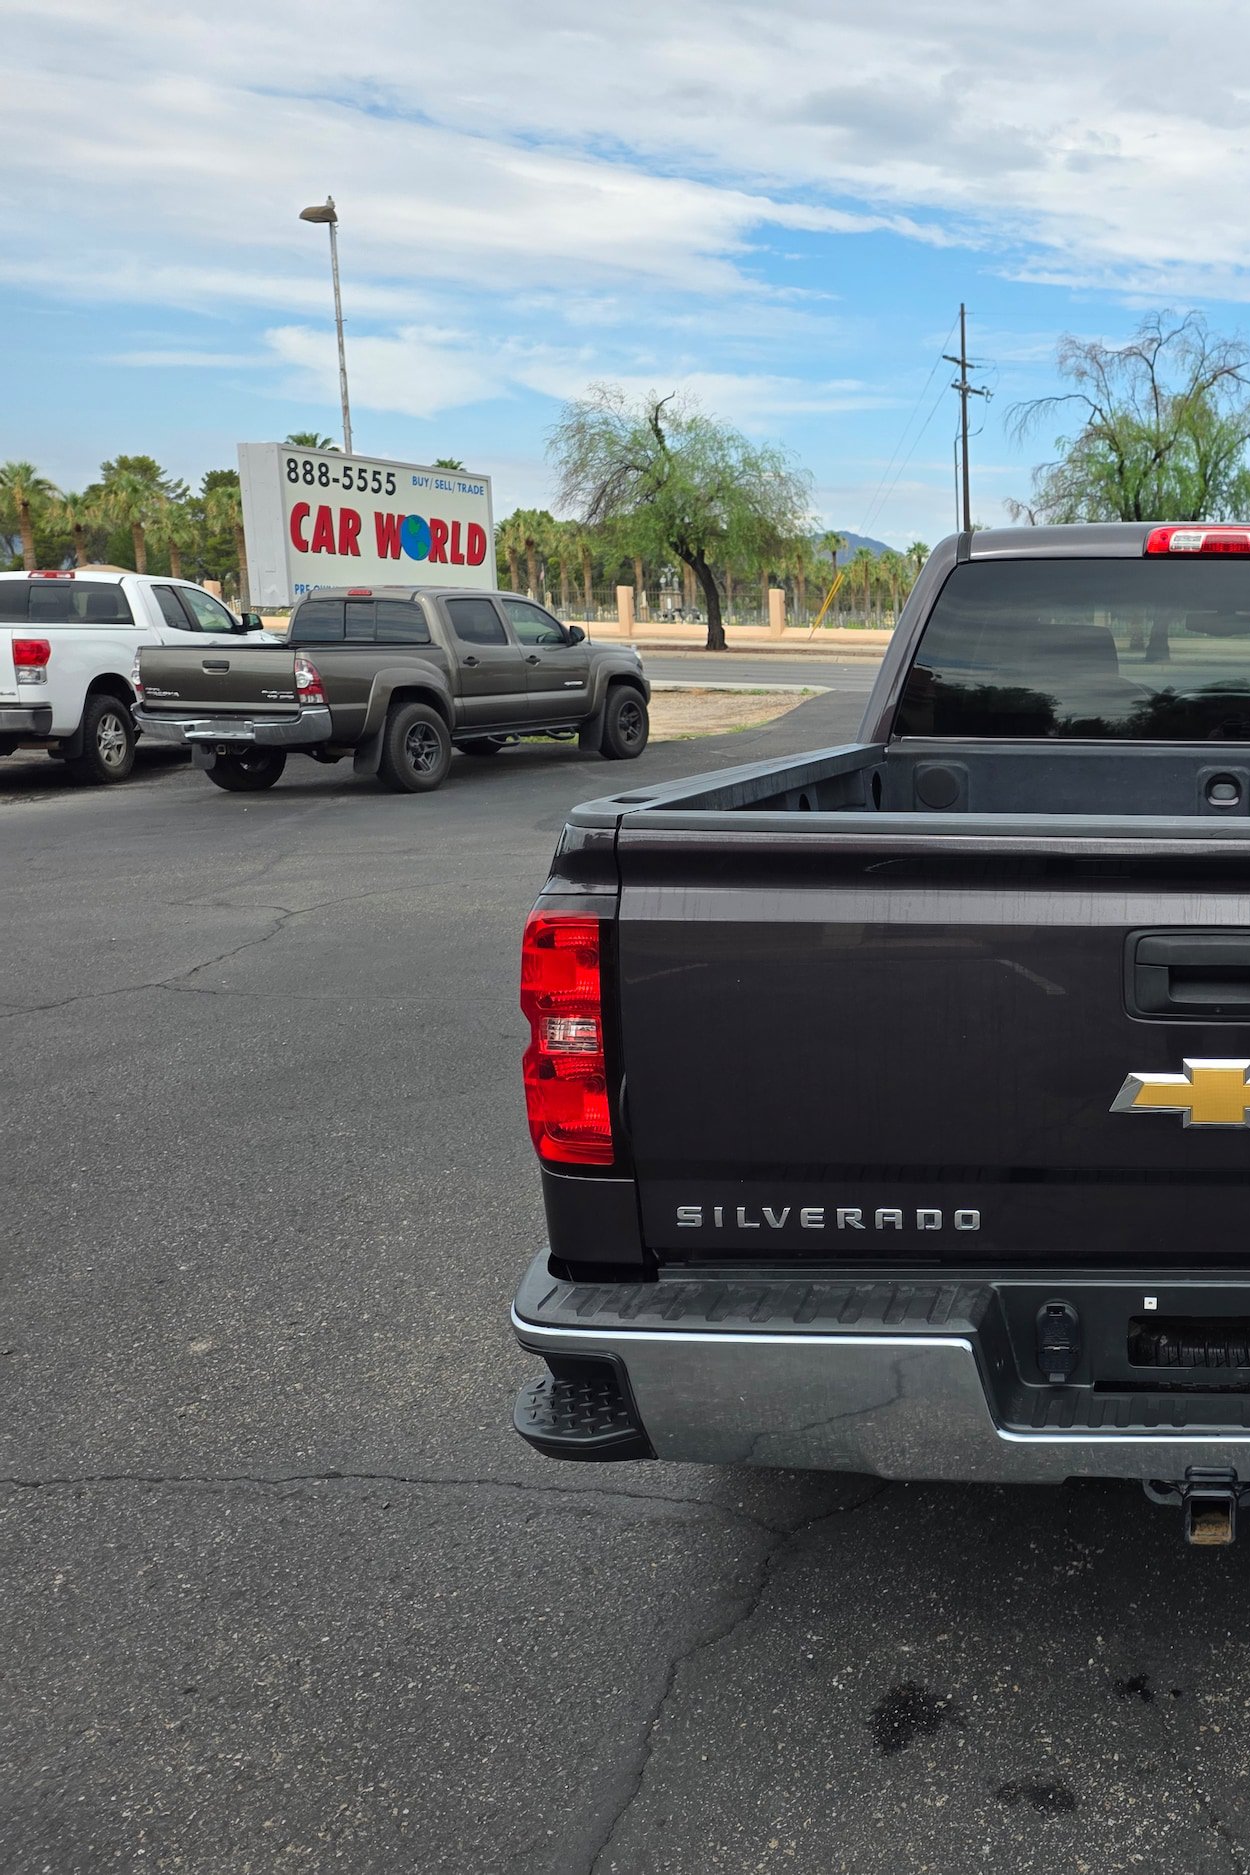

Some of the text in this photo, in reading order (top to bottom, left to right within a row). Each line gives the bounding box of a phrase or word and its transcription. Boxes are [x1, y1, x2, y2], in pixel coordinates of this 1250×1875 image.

[287, 458, 396, 495] 888-5555
[290, 501, 487, 567] CAR WORLD
[676, 1206, 981, 1231] SILVERADO
